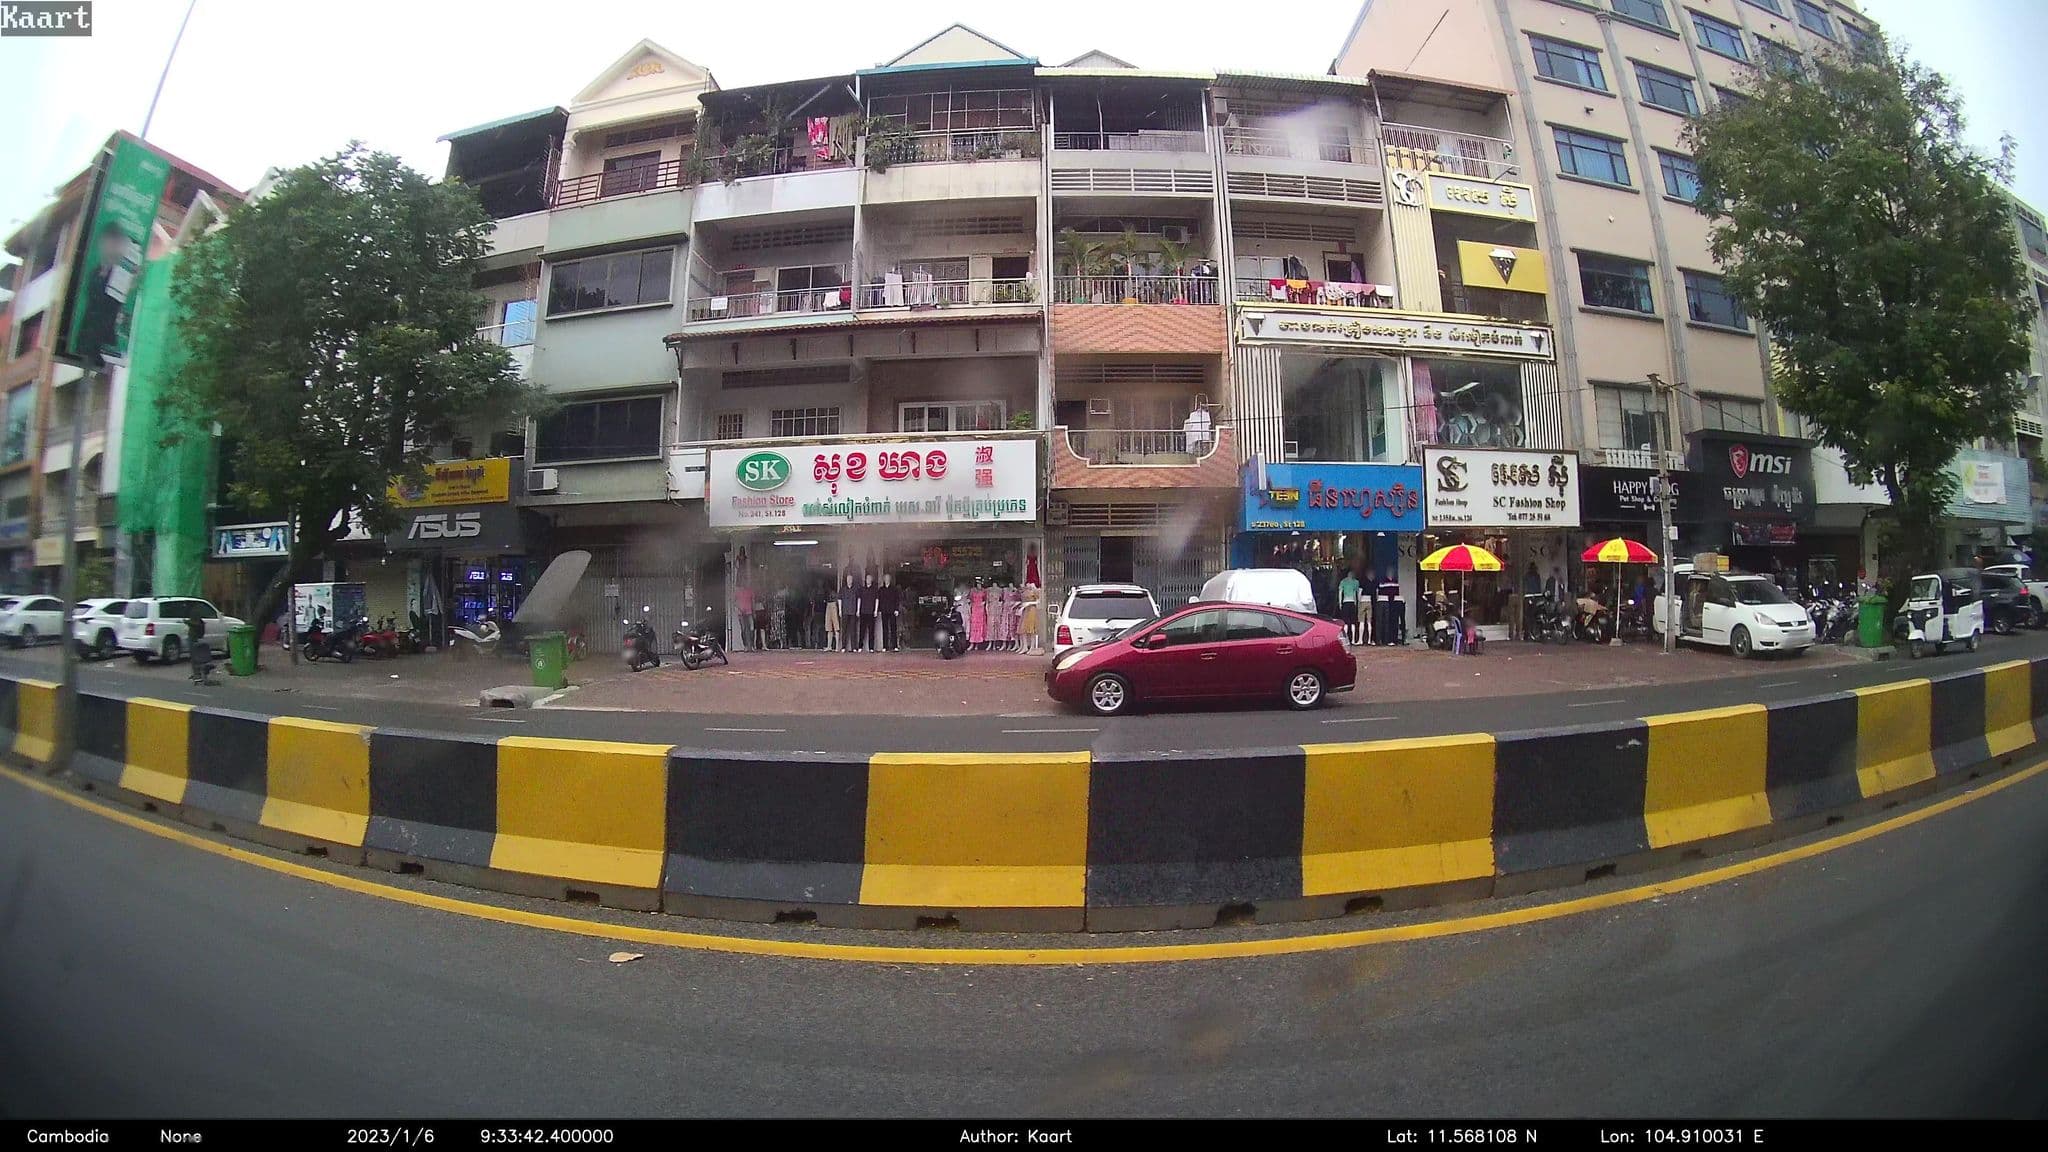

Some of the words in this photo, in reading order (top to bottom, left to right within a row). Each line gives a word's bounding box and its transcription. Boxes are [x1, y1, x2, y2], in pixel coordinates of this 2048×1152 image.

[1749, 452, 1793, 474] msi
[745, 460, 781, 482] SK
[1613, 480, 1648, 495] HAPPY
[732, 496, 767, 506] Fashion
[769, 494, 794, 505] Store
[1493, 496, 1506, 508] SC
[1509, 497, 1543, 509] Fashion
[1545, 497, 1566, 511] Shop
[1632, 495, 1645, 503] Shop
[408, 512, 481, 540] ASUS
